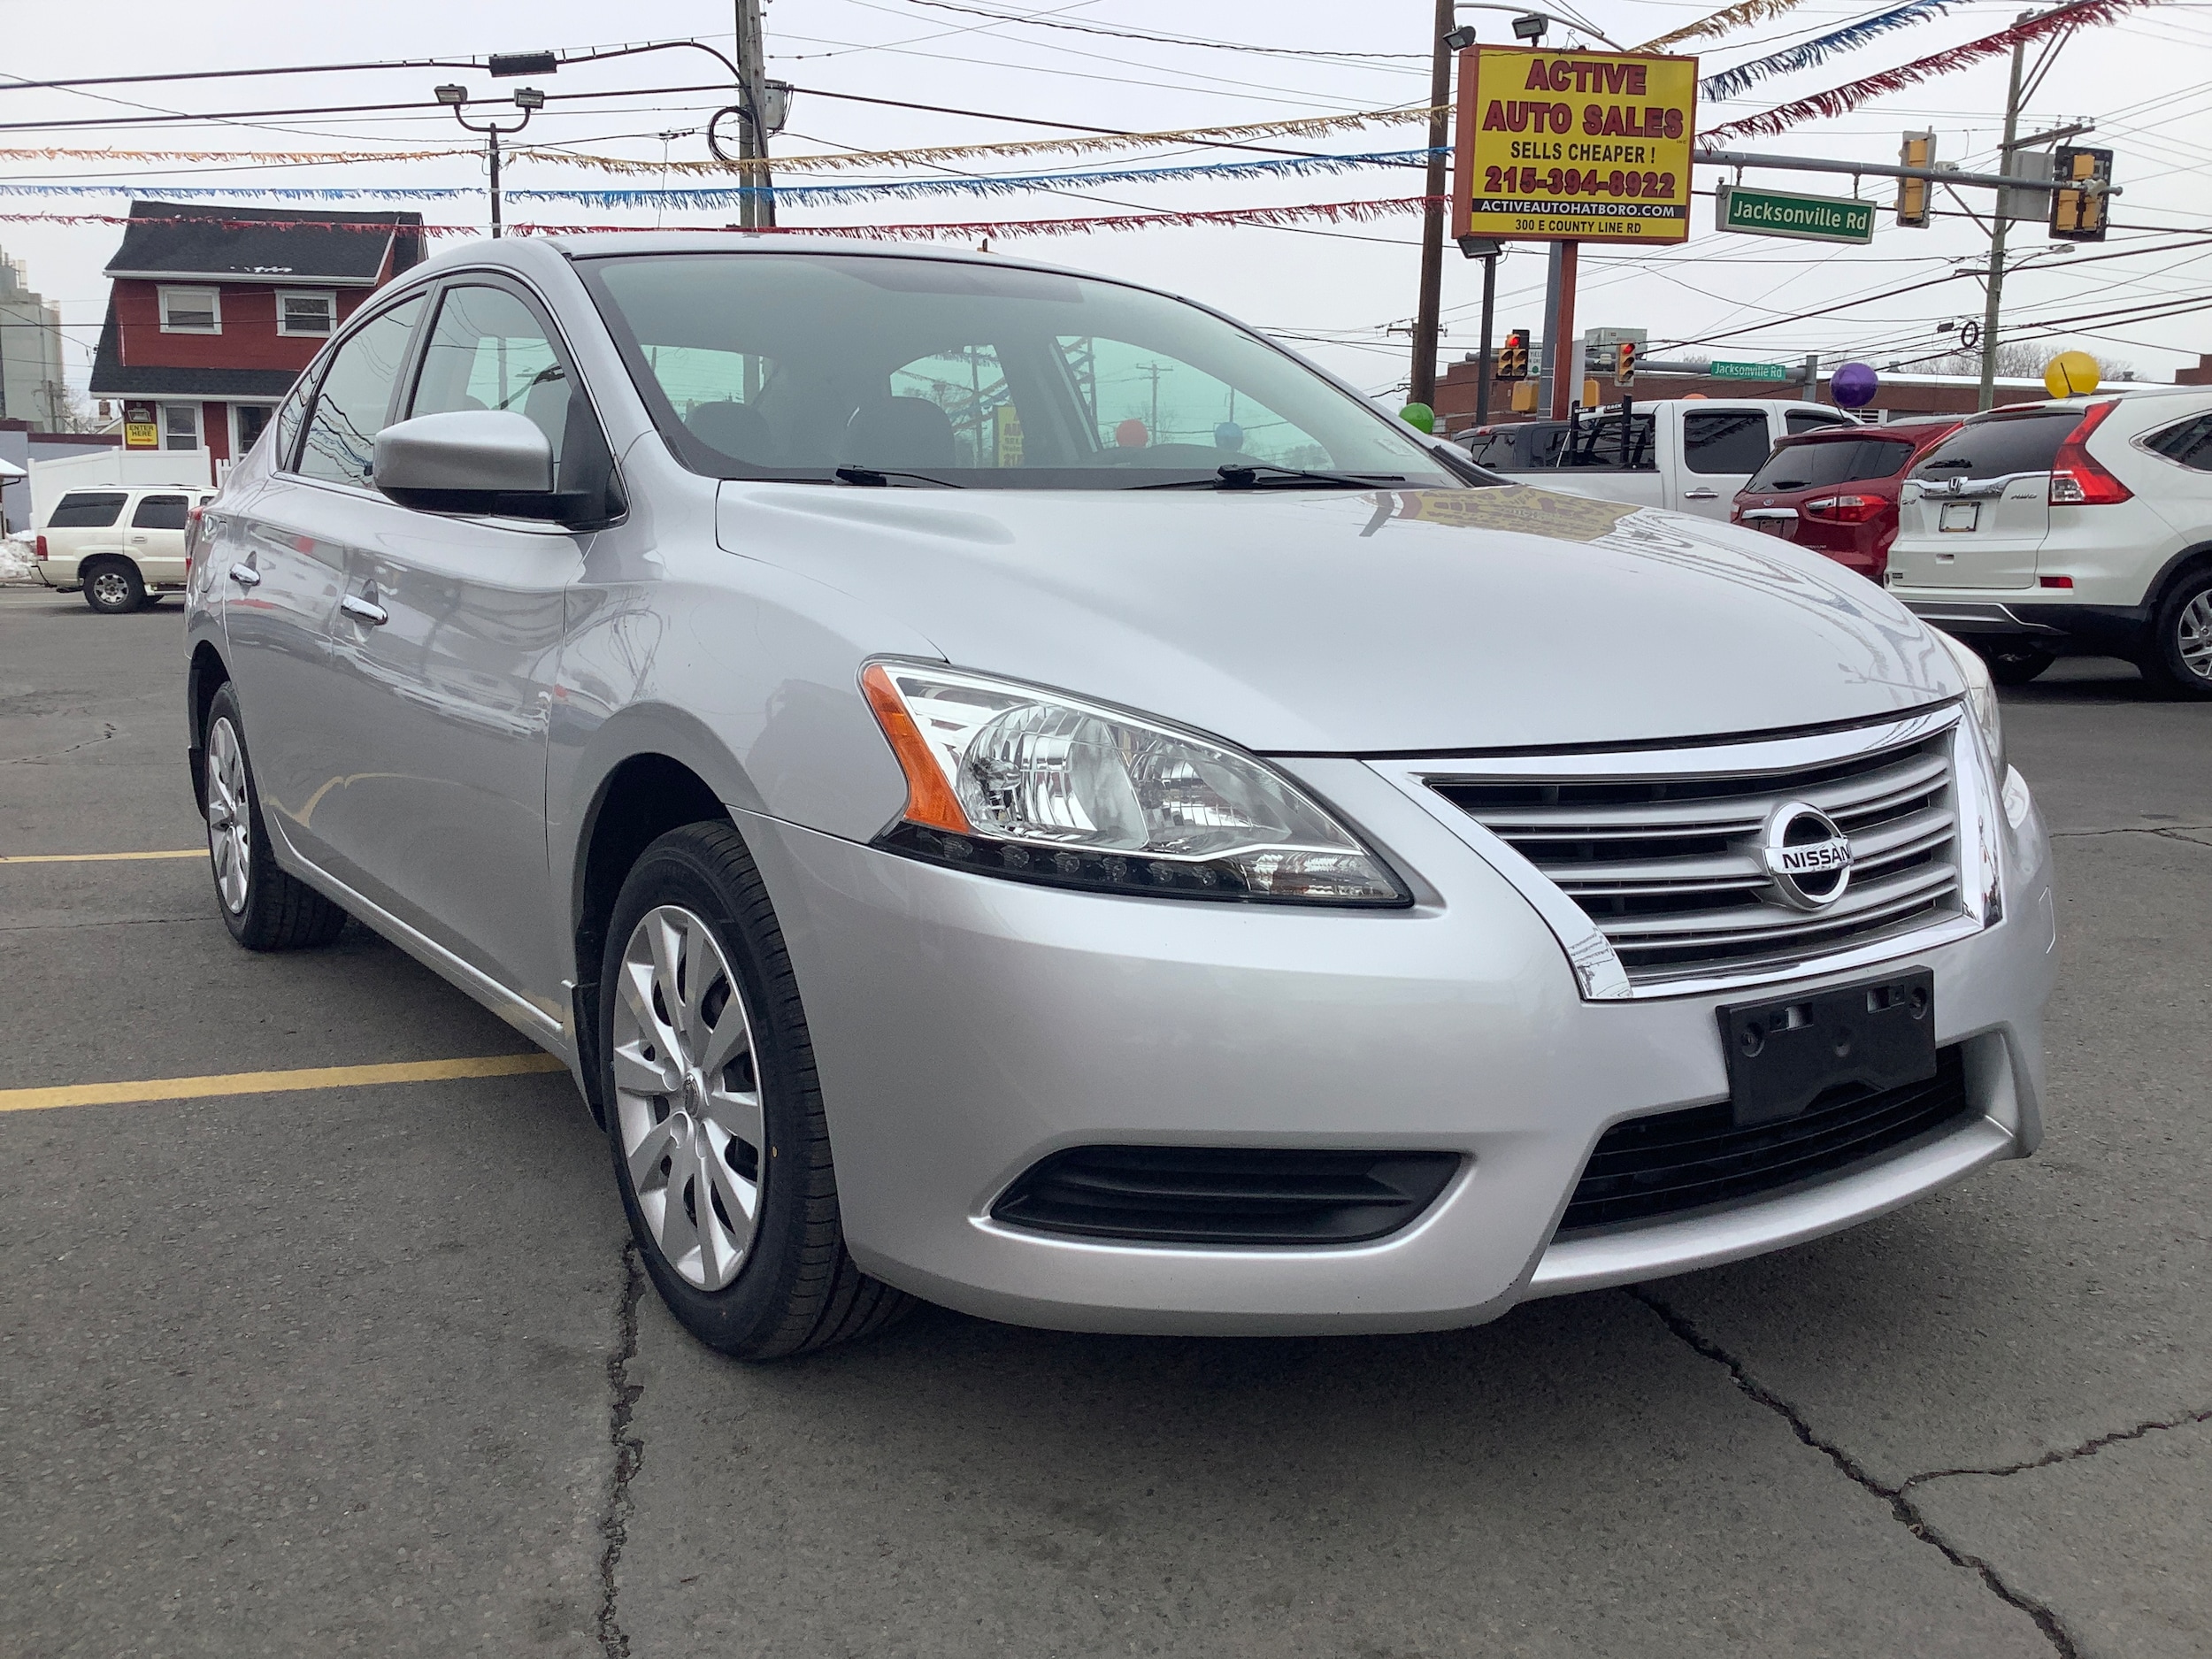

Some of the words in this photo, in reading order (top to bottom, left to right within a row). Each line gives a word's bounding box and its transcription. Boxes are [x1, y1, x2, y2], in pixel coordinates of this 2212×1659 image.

[1525, 58, 1647, 96] ACTIVE
[1482, 100, 1572, 134] AUTO
[1582, 104, 1684, 139] SALES
[1510, 141, 1562, 160] SELLS
[1568, 143, 1645, 163] CHEAPER
[1484, 165, 1675, 198] 215-394-8922
[1481, 200, 1675, 218] ACTIVEAUTOHATBORO.COM
[1733, 200, 1841, 228] Jacksonville
[1846, 211, 1868, 230] Rd
[1516, 219, 1534, 231] 300
[1538, 220, 1545, 231] E
[1548, 220, 1594, 233] COUNTY
[1598, 221, 1623, 233] LINE
[1626, 223, 1641, 234] RD
[1715, 362, 1769, 377] Jacksonville
[1770, 365, 1782, 378] Rd
[1782, 846, 1850, 869] NISSAN
